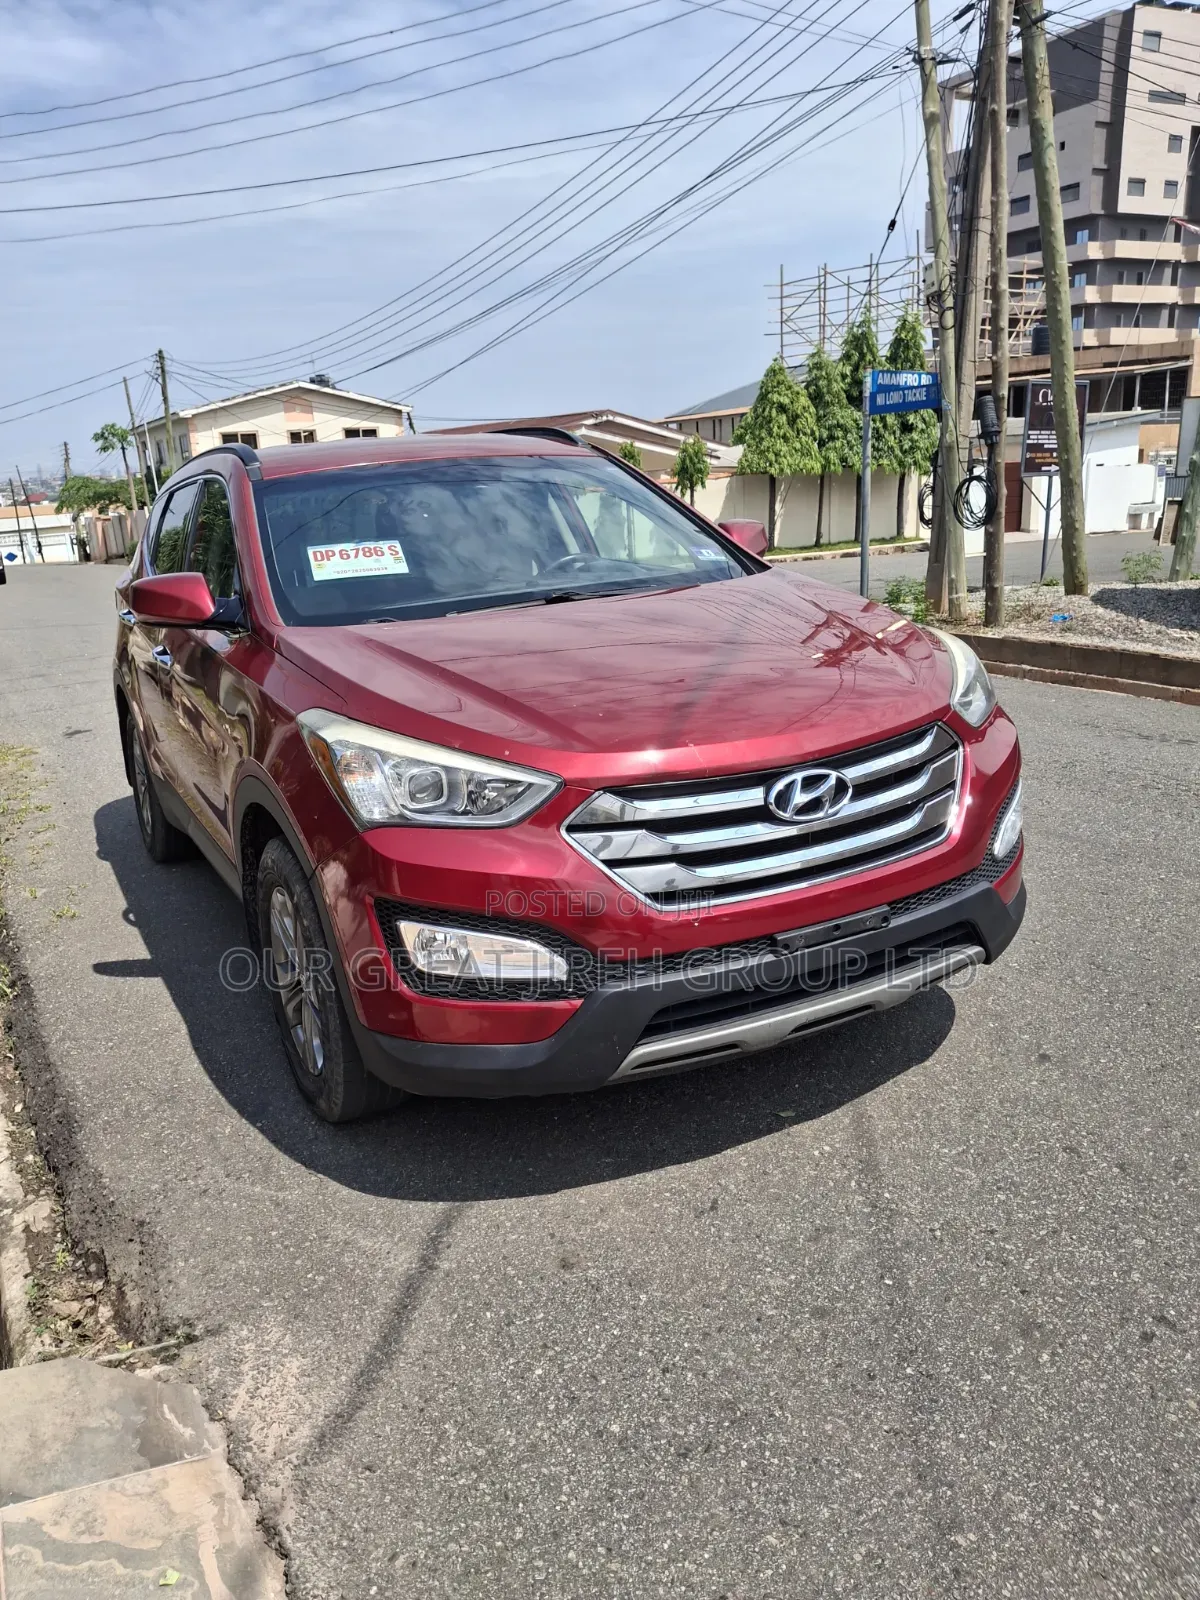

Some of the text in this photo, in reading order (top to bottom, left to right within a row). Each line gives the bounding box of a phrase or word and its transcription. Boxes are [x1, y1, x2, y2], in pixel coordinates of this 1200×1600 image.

[877, 372, 933, 387] AMANFRO RD
[876, 393, 886, 406] NII
[904, 387, 927, 403] TACKIE
[312, 544, 400, 563] DP 6786 S
